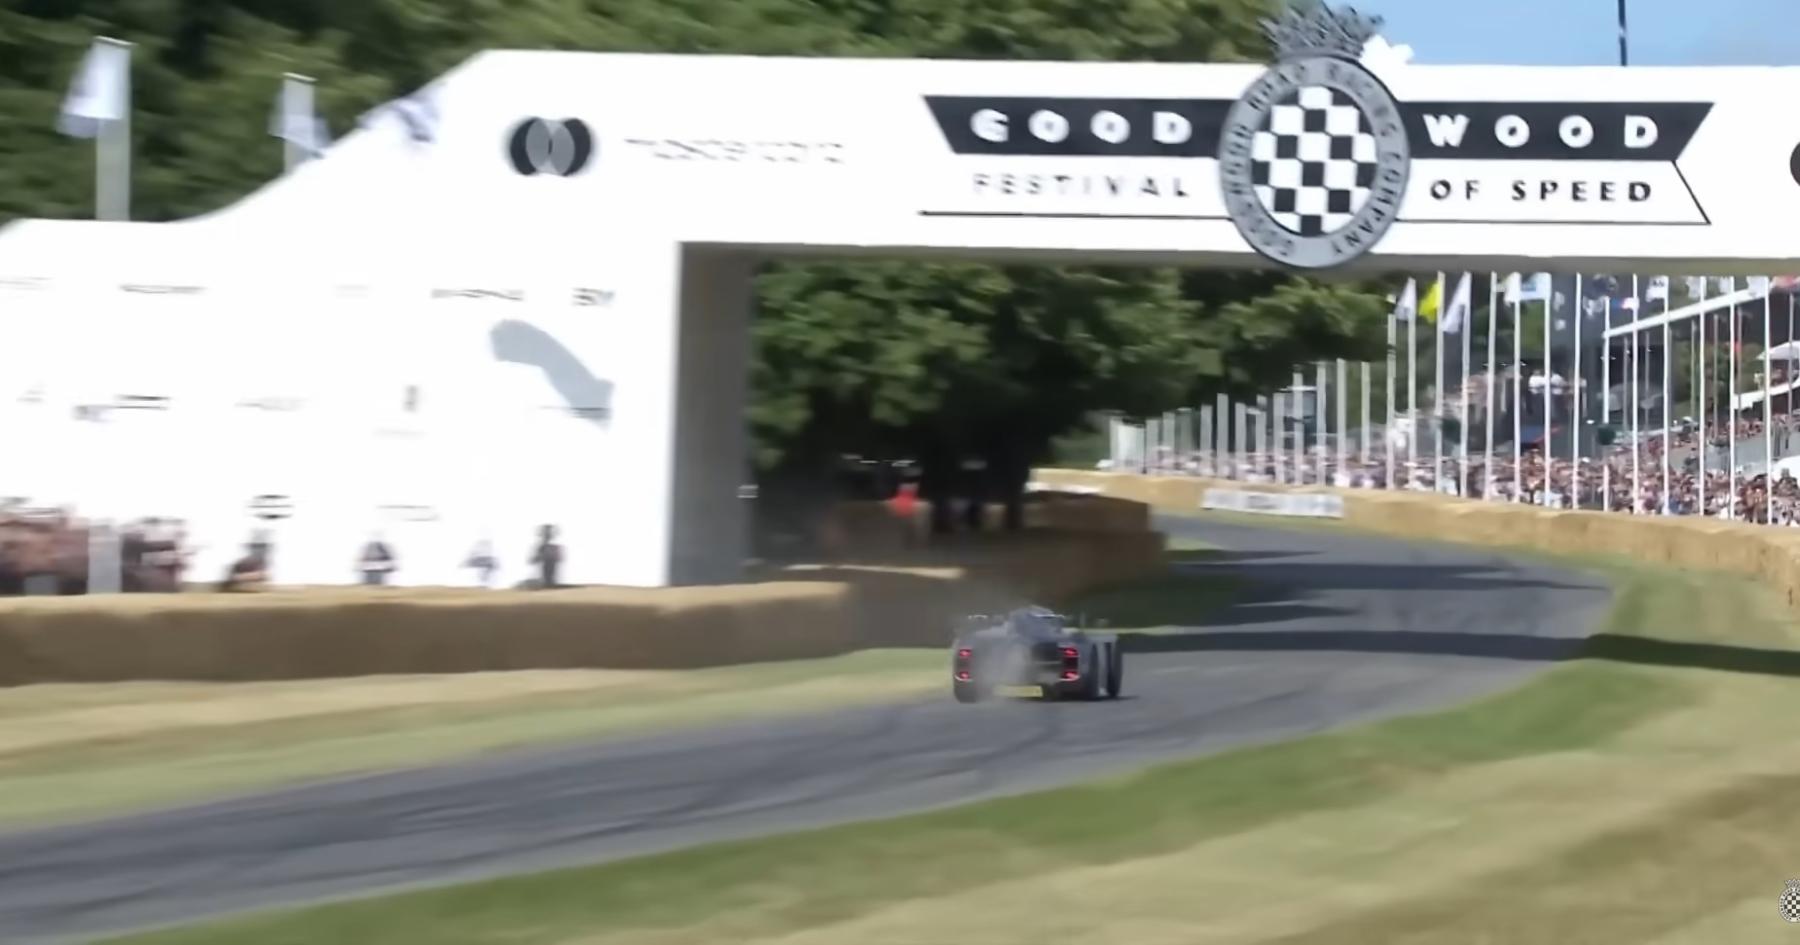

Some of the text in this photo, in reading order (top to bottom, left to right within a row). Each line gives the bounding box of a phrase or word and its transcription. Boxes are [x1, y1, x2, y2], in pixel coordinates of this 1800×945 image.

[970, 108, 1659, 149] GOOD WOOD
[972, 173, 1652, 203] FESTIVAL OF SPEED
